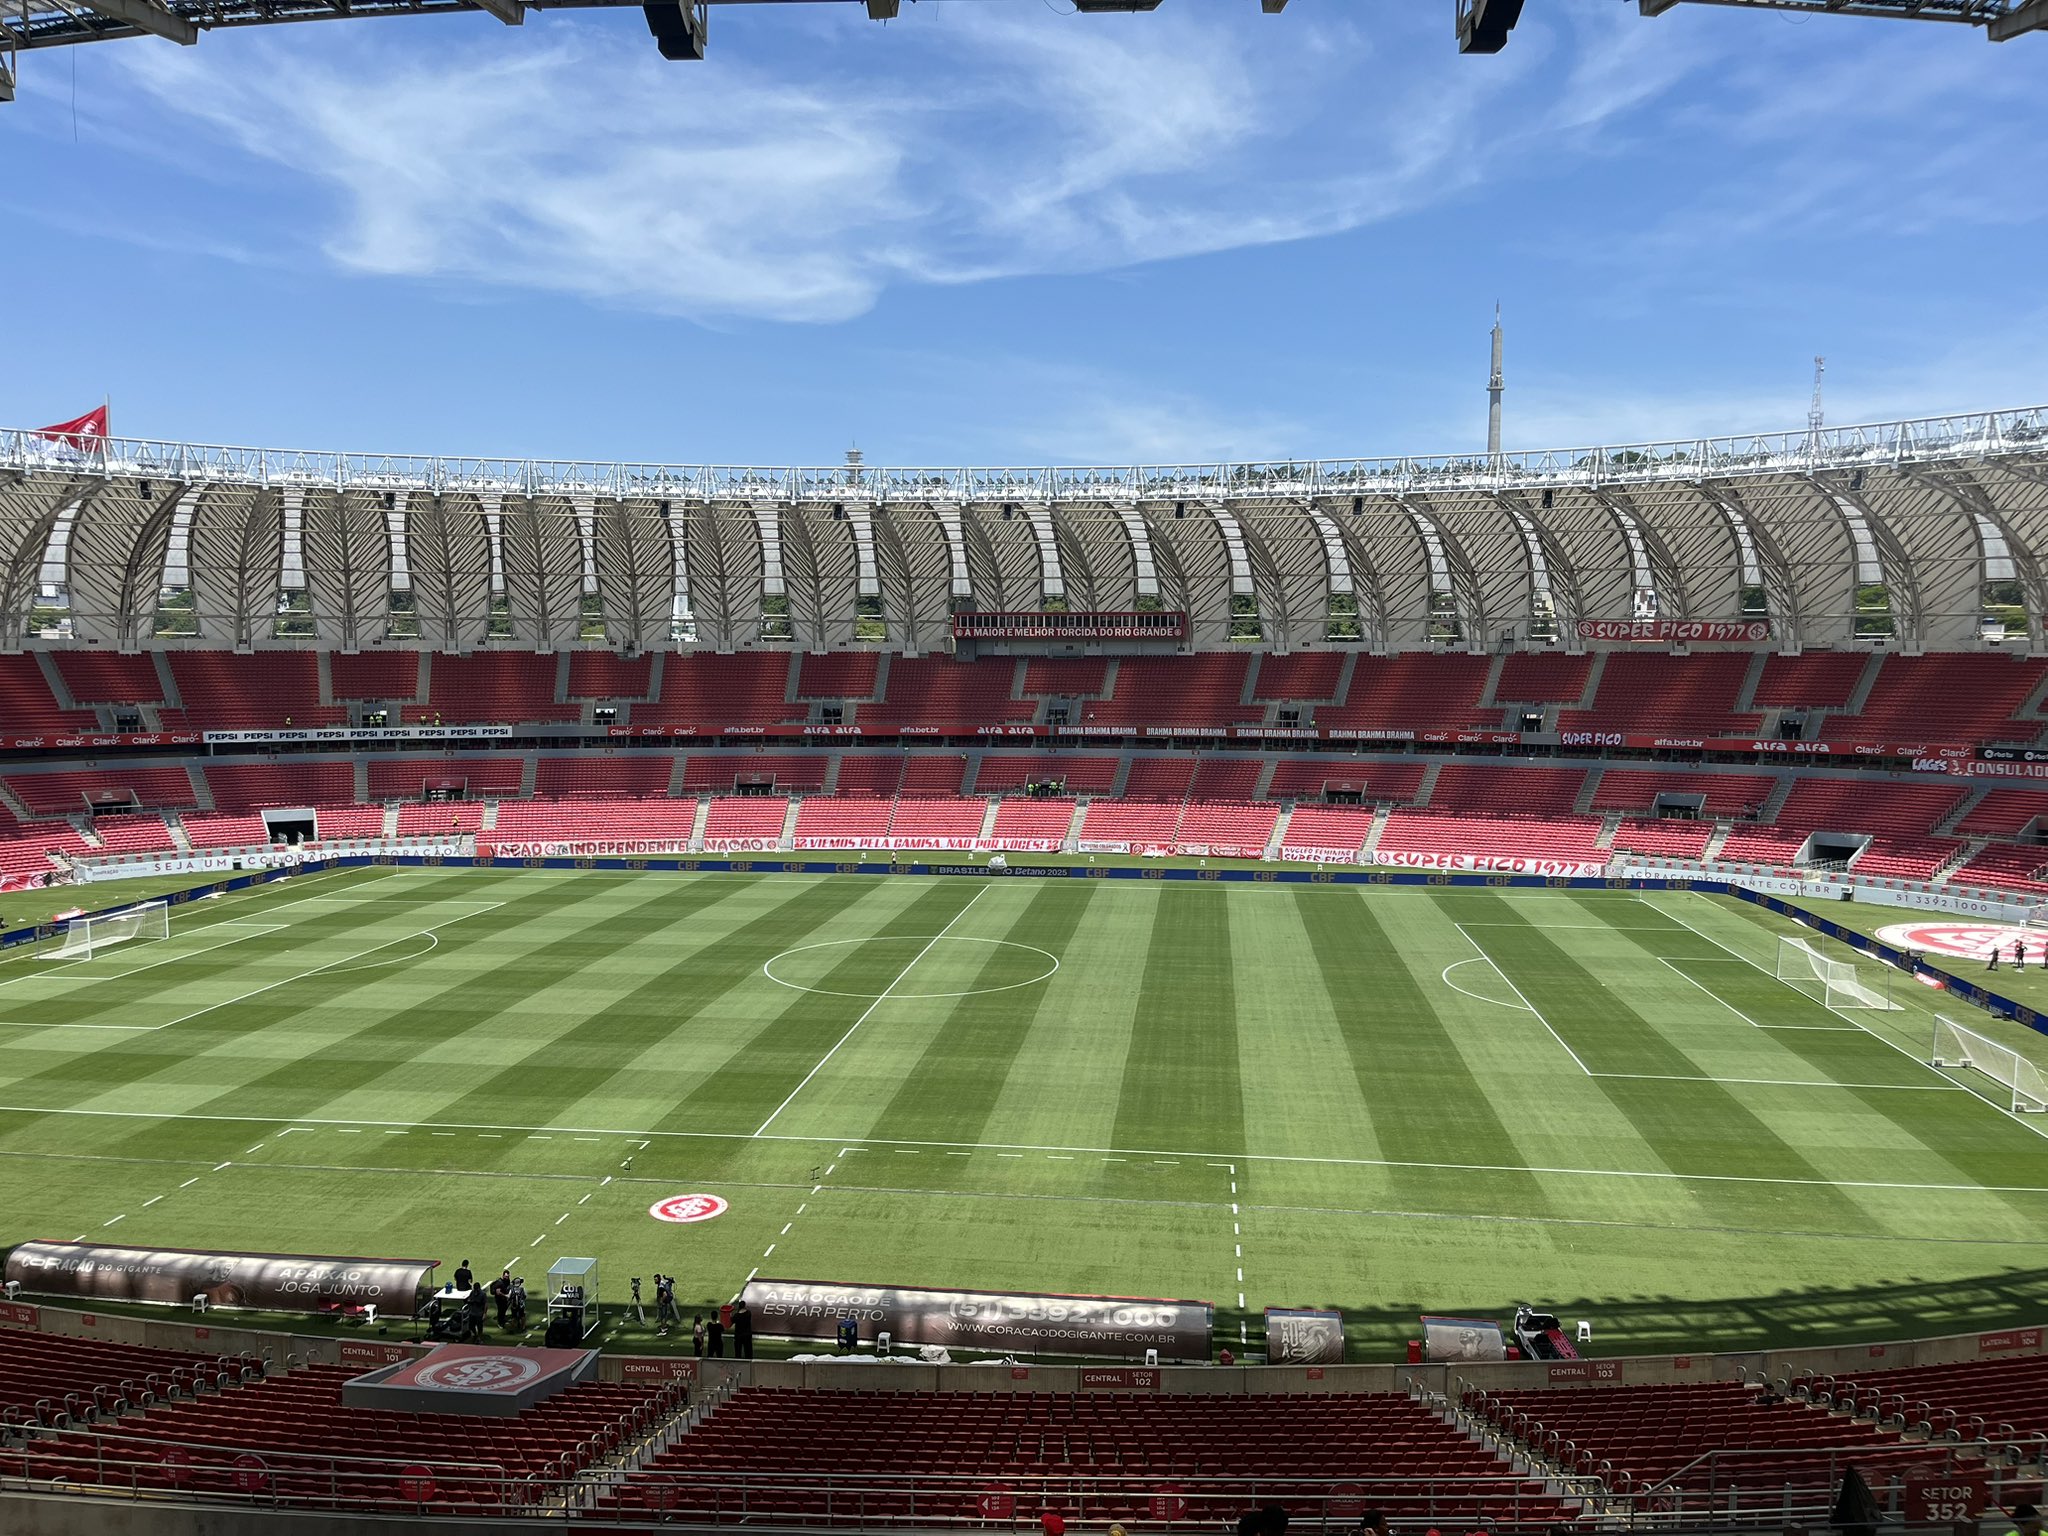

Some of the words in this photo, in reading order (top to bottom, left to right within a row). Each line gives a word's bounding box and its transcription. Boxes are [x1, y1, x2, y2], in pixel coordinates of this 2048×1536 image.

[965, 629, 971, 637] A
[974, 629, 1005, 637] MAIOR
[1007, 629, 1013, 637] E
[1015, 629, 1054, 637] MELHOR
[1056, 629, 1097, 637] TORCIDA
[1100, 629, 1113, 637] DO
[1115, 629, 1131, 637] RIO
[1133, 629, 1173, 637] GRANDE
[1596, 623, 1654, 639] SUPER
[1708, 624, 1745, 639] 1977
[610, 727, 634, 736] Claro
[643, 727, 665, 735] Claro
[674, 727, 696, 735] Claro
[1058, 727, 1084, 735] BRAHMA
[1085, 727, 1110, 735] BRAHMA
[1111, 727, 1137, 735] BRAHMA
[1146, 727, 1172, 735] BRAHMA
[1174, 728, 1200, 736] BRAHMA
[1201, 728, 1227, 736] BRAHMA
[1237, 728, 1263, 737] BRAHMA
[1264, 729, 1291, 737] BRAHMA
[1292, 729, 1319, 737] BRAHMA
[1329, 730, 1356, 738] BRAHMA
[1358, 731, 1385, 739] BRAHMA
[1387, 731, 1414, 739] BRAHMA
[16, 737, 44, 747] Claro
[56, 736, 84, 747] Claro
[93, 735, 120, 745] Claro
[132, 734, 160, 744] Claro
[171, 733, 199, 743] Claro
[1424, 732, 1448, 741] Claro
[1458, 733, 1482, 742] Claro
[1492, 734, 1517, 742] Claro
[1562, 733, 1592, 745] SUPER
[1654, 738, 1703, 748] alfa.bet.br
[1752, 742, 1787, 751] alfa
[1795, 743, 1829, 752] alfa
[1855, 745, 1885, 754] Claro
[1897, 745, 1927, 756] Claro
[1940, 747, 1970, 757] Claro
[570, 840, 688, 854] INDEPENDENTE
[810, 838, 855, 847] VIEMOS
[860, 838, 889, 848] PELA
[975, 839, 999, 849] POR
[155, 861, 193, 871] SEJA
[205, 859, 227, 868] UM
[372, 856, 393, 865] CBF
[423, 857, 444, 865] CBF
[472, 858, 494, 867] CBF
[523, 859, 545, 867] CBF
[574, 859, 596, 868] CBF
[626, 861, 648, 869] CBF
[1393, 852, 1464, 869] SUPER
[1535, 862, 1579, 875] 1977
[678, 861, 700, 870] CBF
[730, 862, 752, 870] CBF
[783, 863, 805, 872] CBF
[836, 864, 858, 872] CBF
[889, 865, 912, 873] CBF
[939, 867, 1012, 875] BRASILEIO
[1015, 867, 1045, 876] Betano
[1086, 869, 1110, 877] CBF
[1141, 869, 1165, 878] CBF
[1197, 871, 1221, 879] CBF
[1253, 872, 1278, 881] CBF
[1311, 873, 1335, 882] CBF
[1368, 874, 1393, 883] CBF
[1427, 875, 1452, 884] CBF
[1486, 877, 1511, 886] CBF
[1545, 878, 1571, 887] CBF
[1606, 879, 1631, 888] CBF
[1666, 881, 1692, 890] CBF
[1896, 894, 1908, 902] 51
[1916, 896, 1987, 912] 3392.1000
[2015, 1005, 2036, 1025] CBF
[117, 1265, 162, 1274] GIGANTE
[279, 1268, 291, 1278] A
[275, 1281, 321, 1293] JOGA
[323, 1283, 384, 1296] JUNTO.
[765, 1291, 778, 1300] A
[866, 1297, 891, 1307] DE
[763, 1303, 822, 1317] ESTAR
[824, 1307, 887, 1321] PERTO.
[949, 1302, 1002, 1321] (51)
[1008, 1304, 1177, 1328] 3392.1000
[947, 1322, 1176, 1344] WWW.CORACAODOGIGANTE.COM.BR
[1982, 1338, 2011, 1347] LATERAL
[342, 1347, 375, 1357] CENTRAL
[625, 1365, 660, 1373] CENTRAL
[672, 1369, 686, 1377] 101
[1551, 1368, 1586, 1376] CENTRAL
[1135, 1378, 1151, 1386] 102
[1921, 1486, 1972, 1500] SETOR
[1926, 1503, 1973, 1524] 352
